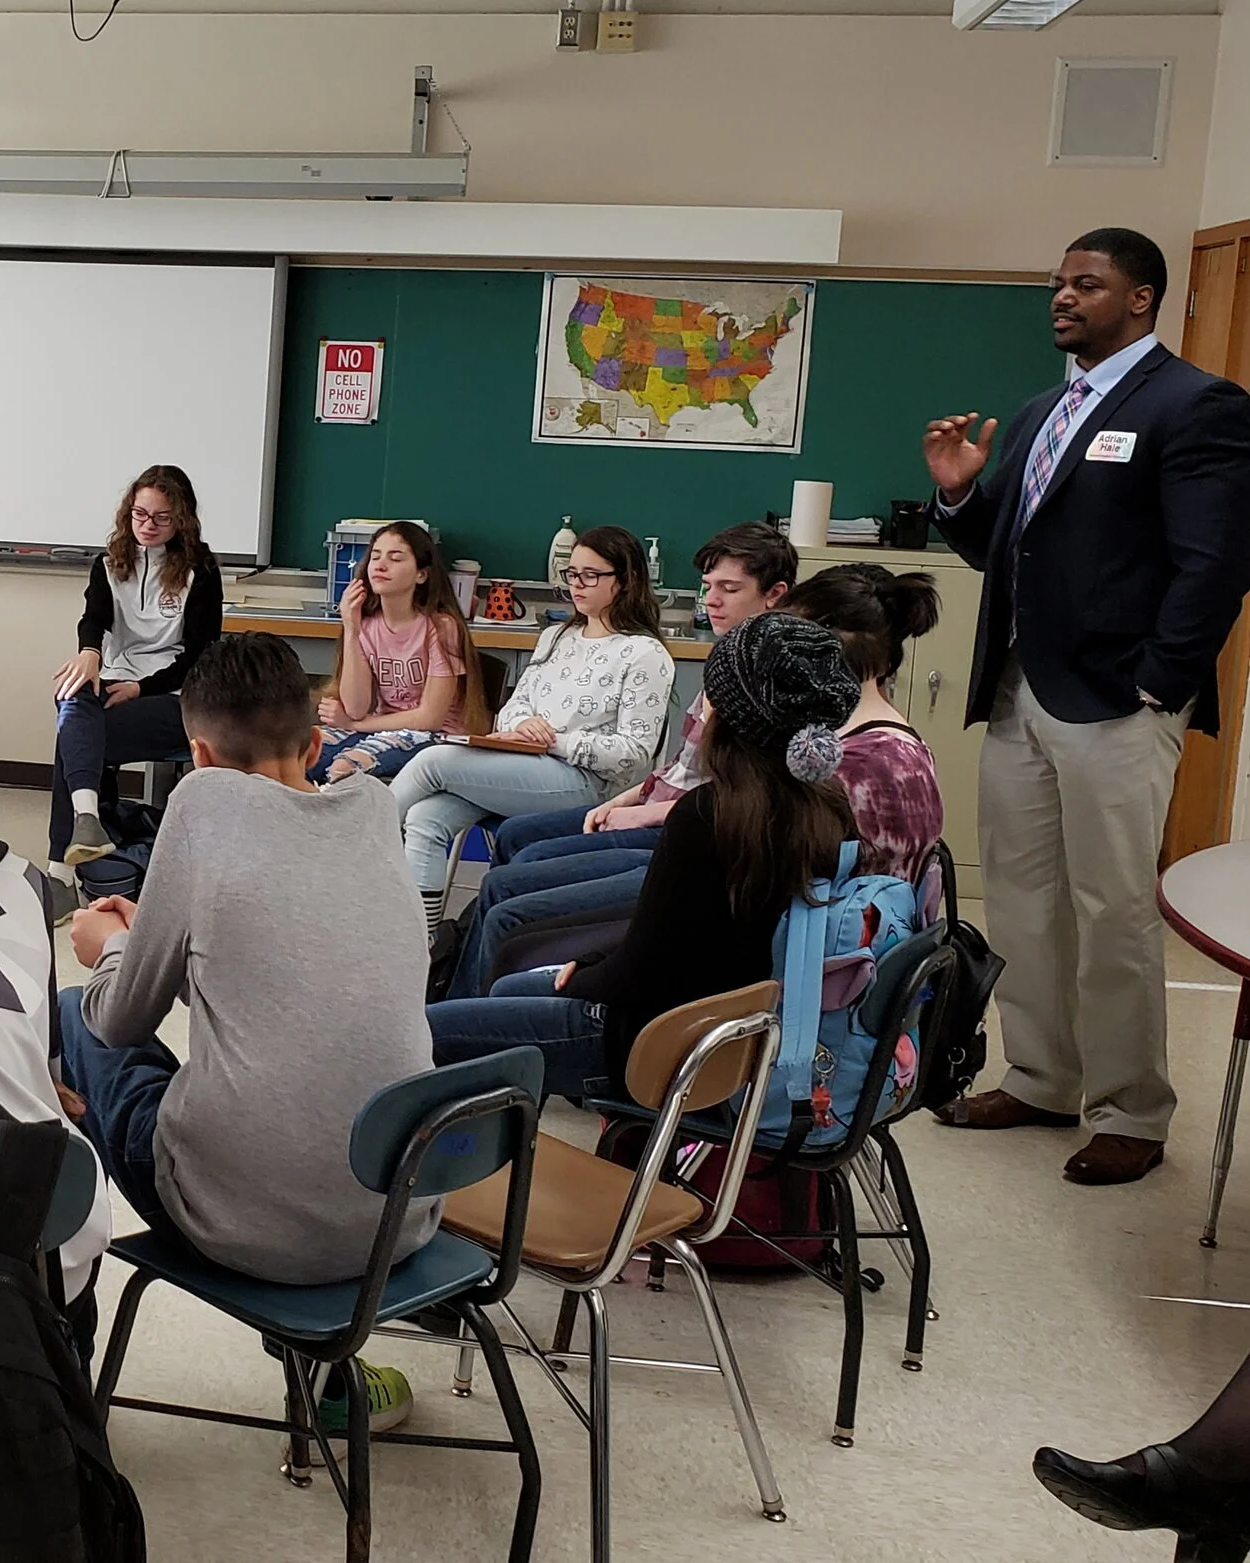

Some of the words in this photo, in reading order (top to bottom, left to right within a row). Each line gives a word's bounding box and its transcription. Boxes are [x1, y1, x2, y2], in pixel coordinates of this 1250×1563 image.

[337, 348, 362, 369] NO
[335, 374, 362, 386] CELL
[329, 388, 366, 400] PHONE
[331, 403, 361, 415] ZONE
[1098, 434, 1128, 444] Adrian
[1099, 443, 1121, 452] Hale
